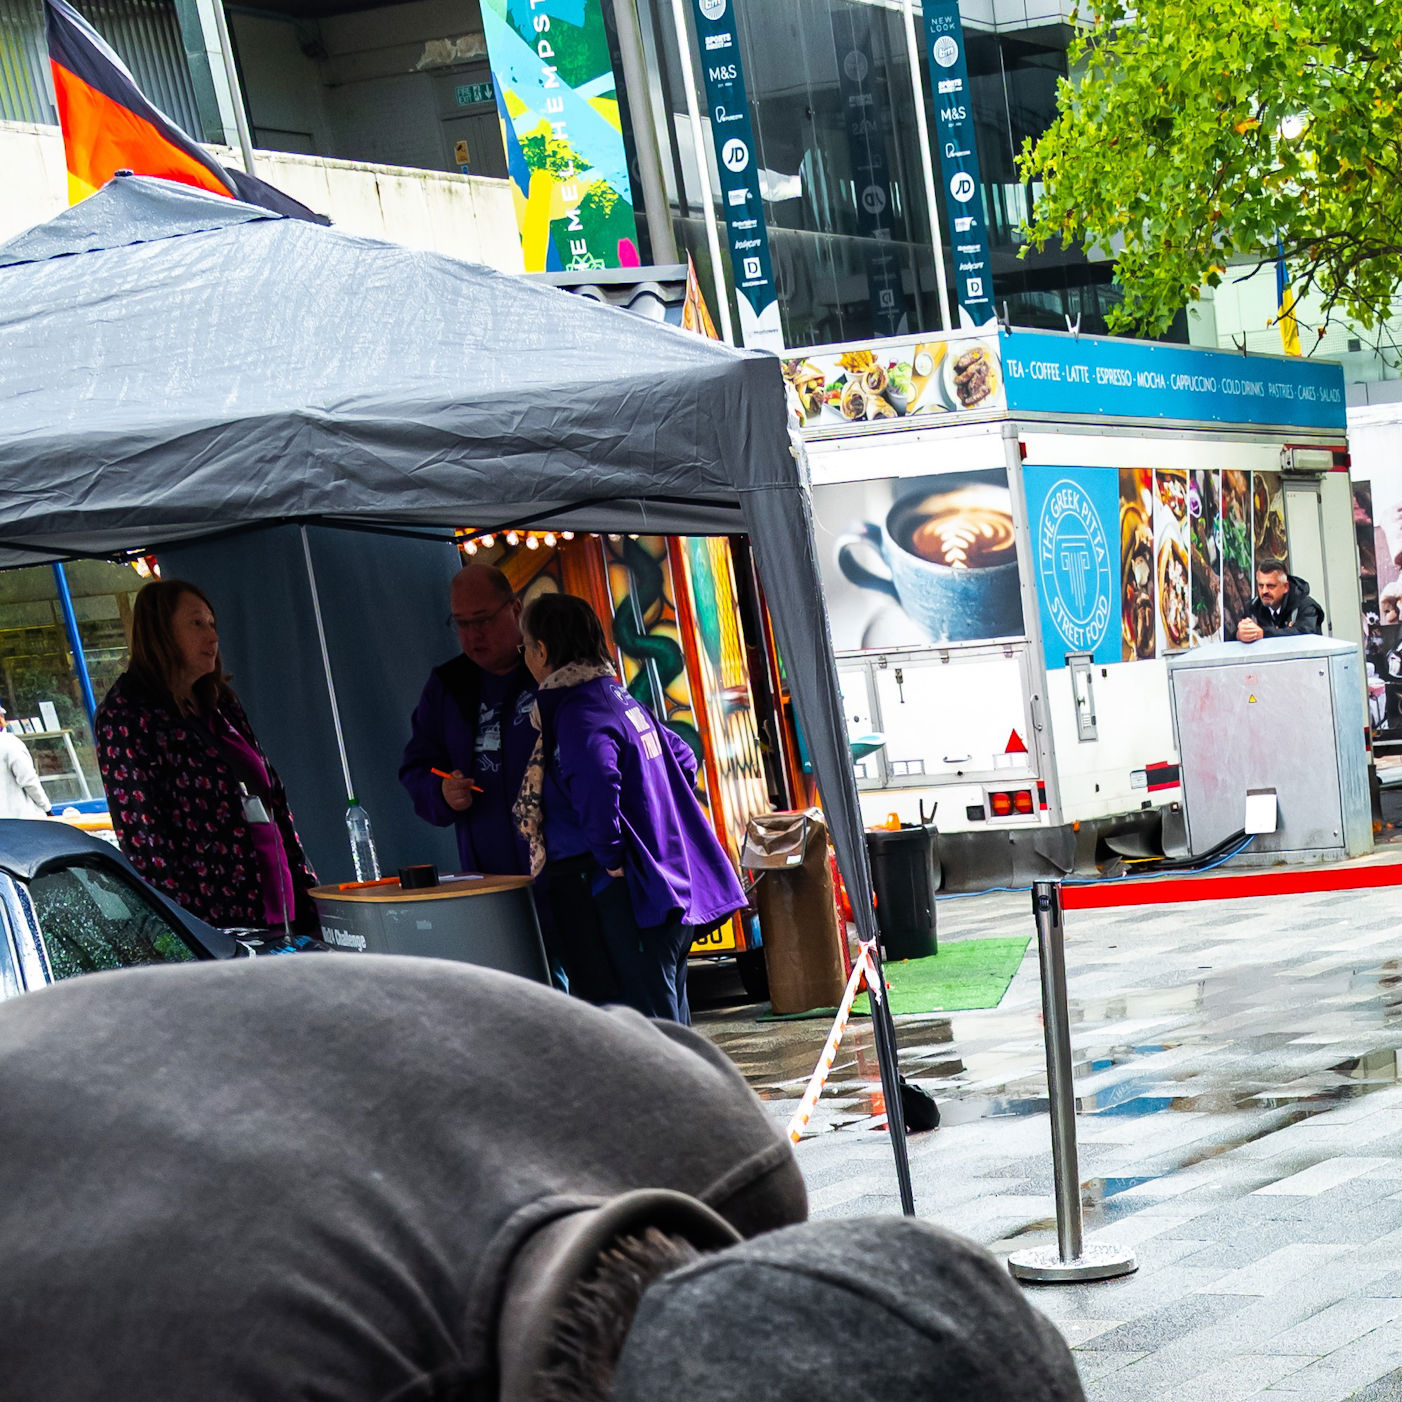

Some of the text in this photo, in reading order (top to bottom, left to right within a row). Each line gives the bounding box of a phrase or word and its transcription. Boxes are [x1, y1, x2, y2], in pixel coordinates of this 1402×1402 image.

[930, 23, 955, 33] LOOK
[931, 16, 953, 25] NEW
[709, 64, 737, 82] M&S
[941, 106, 967, 122] M&S
[728, 146, 745, 165] JD
[955, 180, 971, 195] JD
[748, 261, 758, 275] D
[970, 281, 980, 294] D
[1007, 359, 1341, 403] TEA COFFEE LATTE ESPRESSO MOCHA CAPPUCCINO COLD DRINKS PASTRIES CAKES SALADS
[1043, 488, 1105, 563] THE GREEK PITTA
[1051, 595, 1108, 648] STREET FOOD
[334, 928, 367, 953] Challenge
